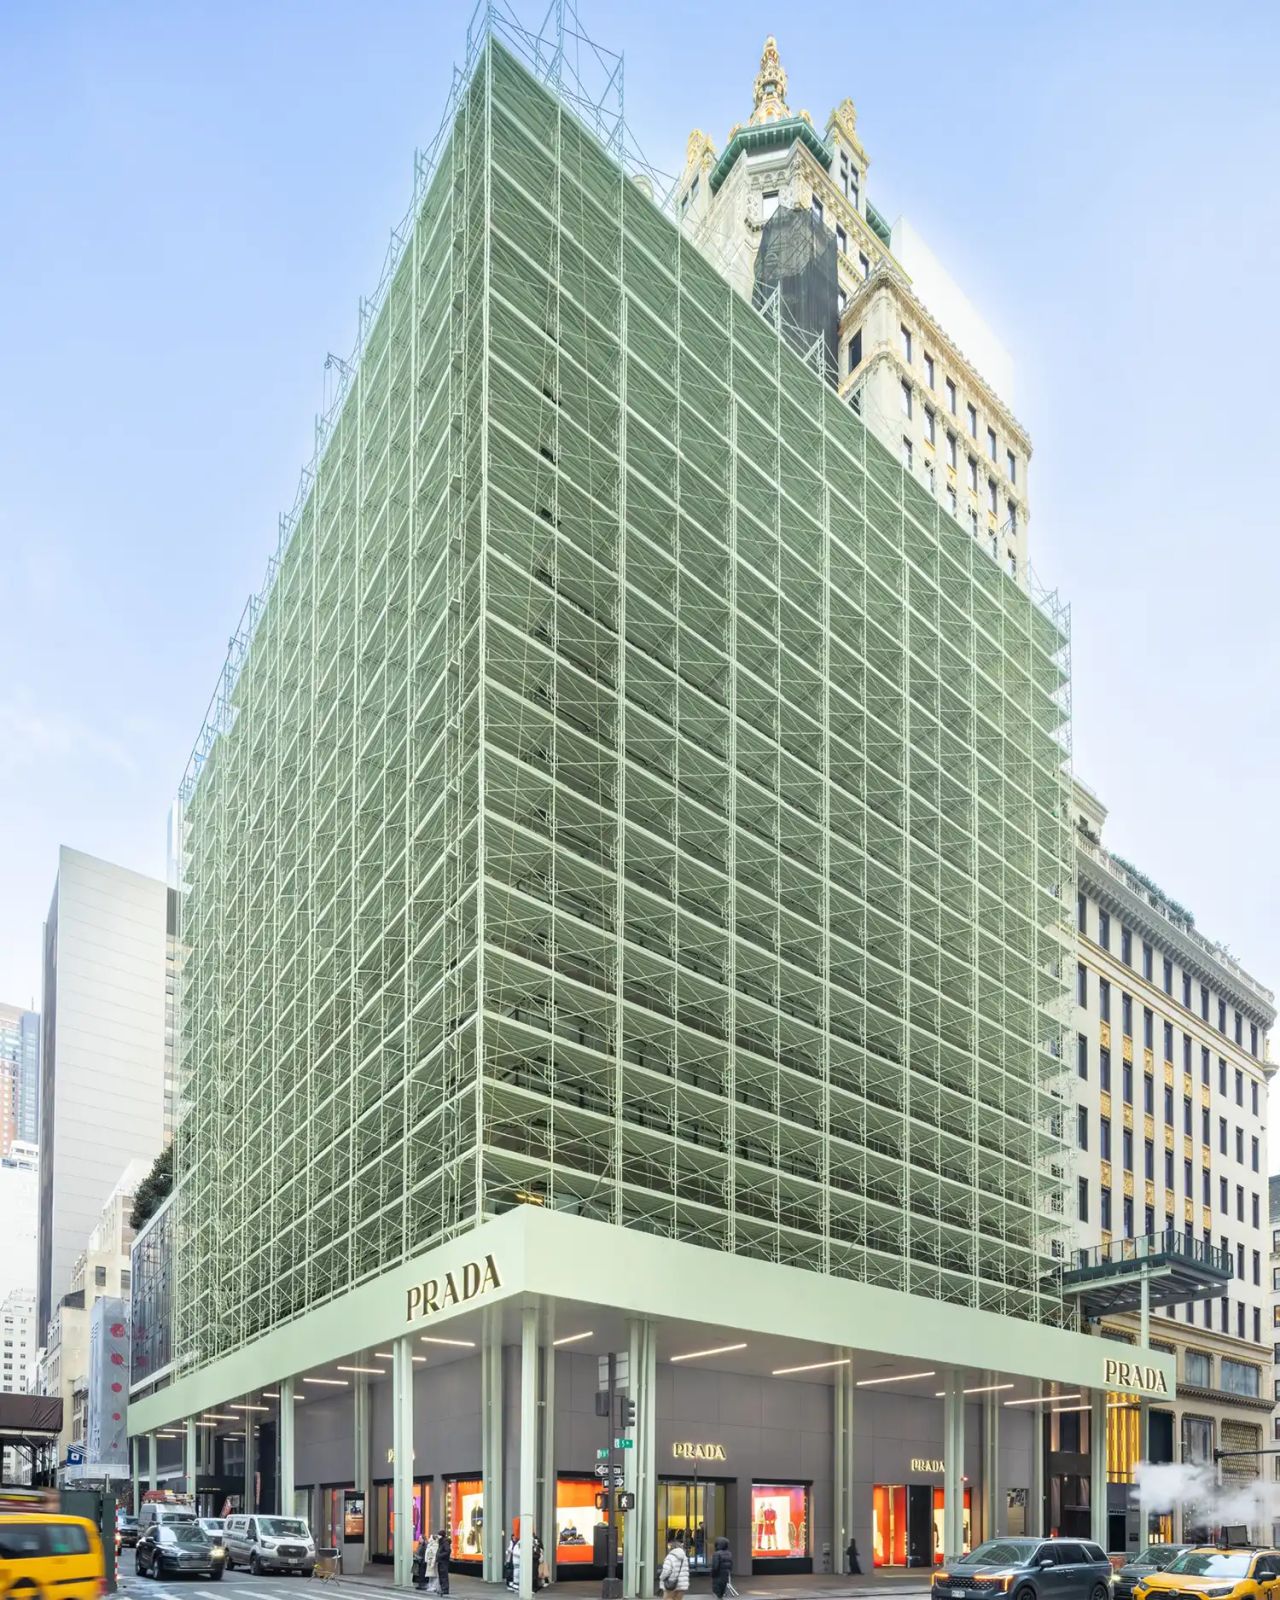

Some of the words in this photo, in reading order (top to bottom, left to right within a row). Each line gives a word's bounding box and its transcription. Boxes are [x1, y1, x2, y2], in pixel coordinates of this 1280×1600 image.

[406, 1253, 502, 1323] PRADA
[1104, 1358, 1168, 1393] PRADA
[673, 1442, 726, 1461] PRADA
[911, 1458, 946, 1472] PRADA
